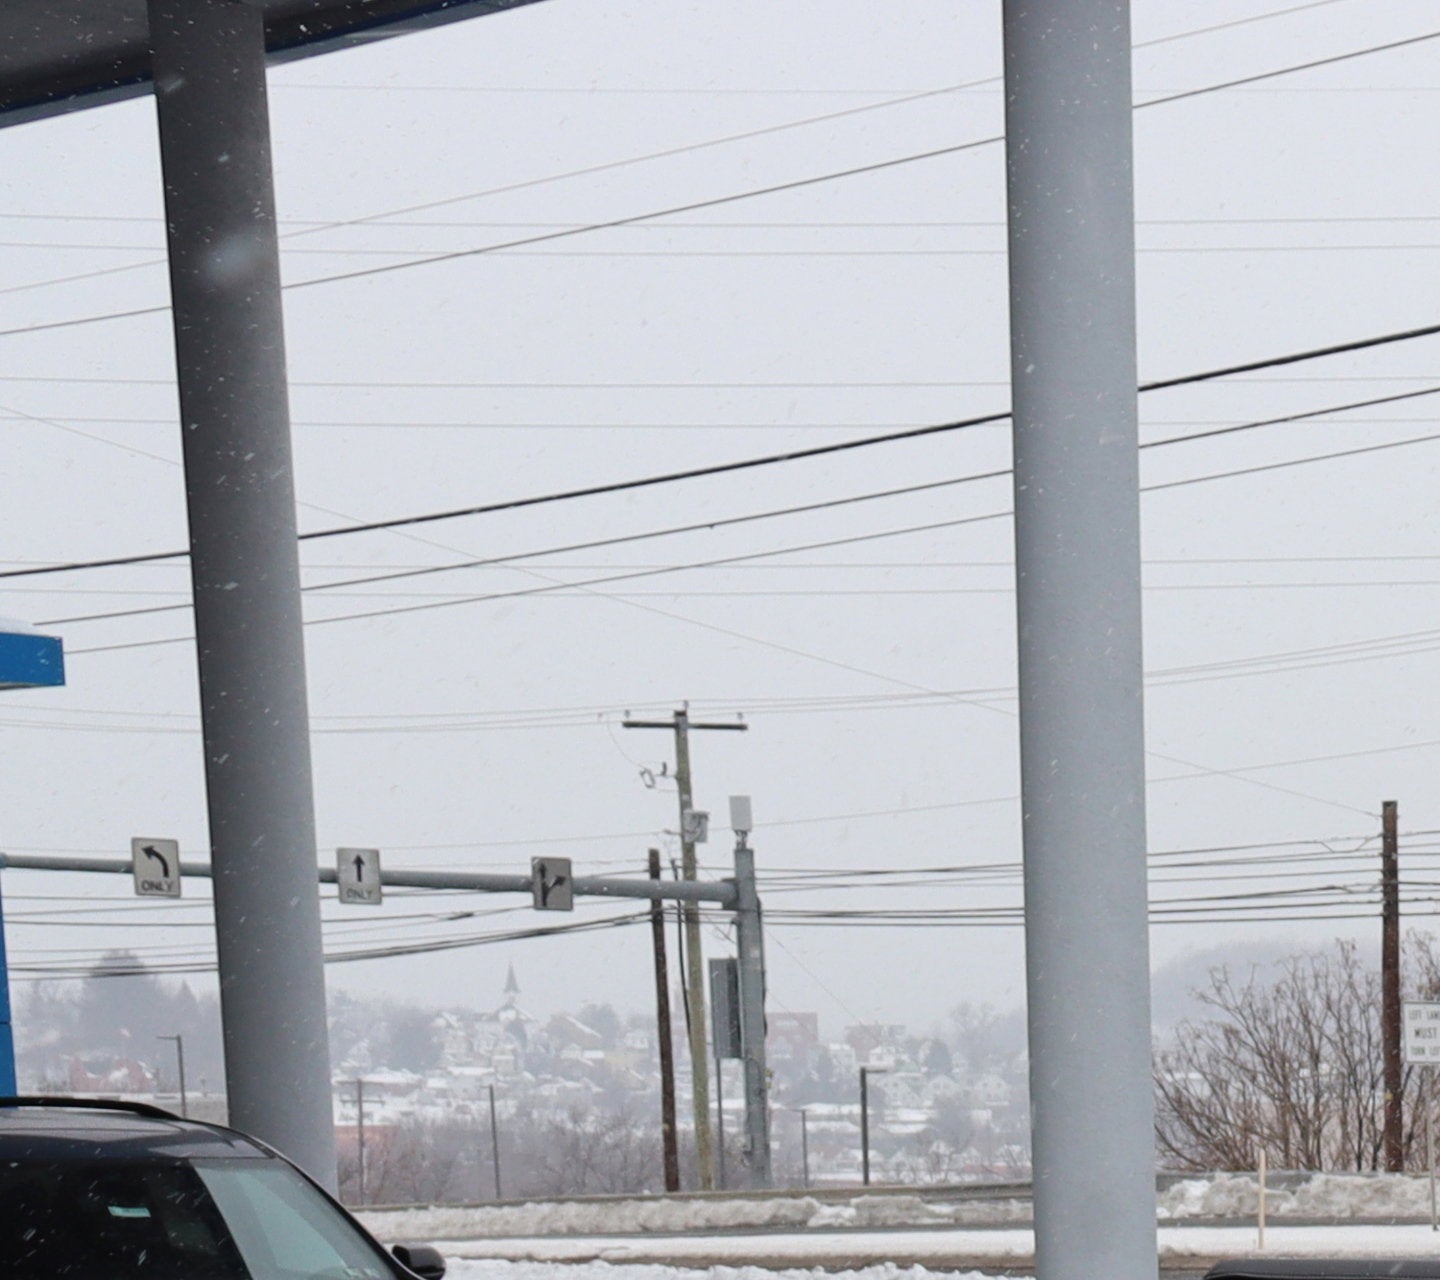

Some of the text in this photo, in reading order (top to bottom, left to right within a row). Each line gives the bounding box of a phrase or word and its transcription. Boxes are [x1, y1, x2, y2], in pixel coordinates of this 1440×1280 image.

[141, 879, 173, 892] ONLY
[346, 887, 373, 899] ONLY
[1414, 1026, 1437, 1039] MUST
